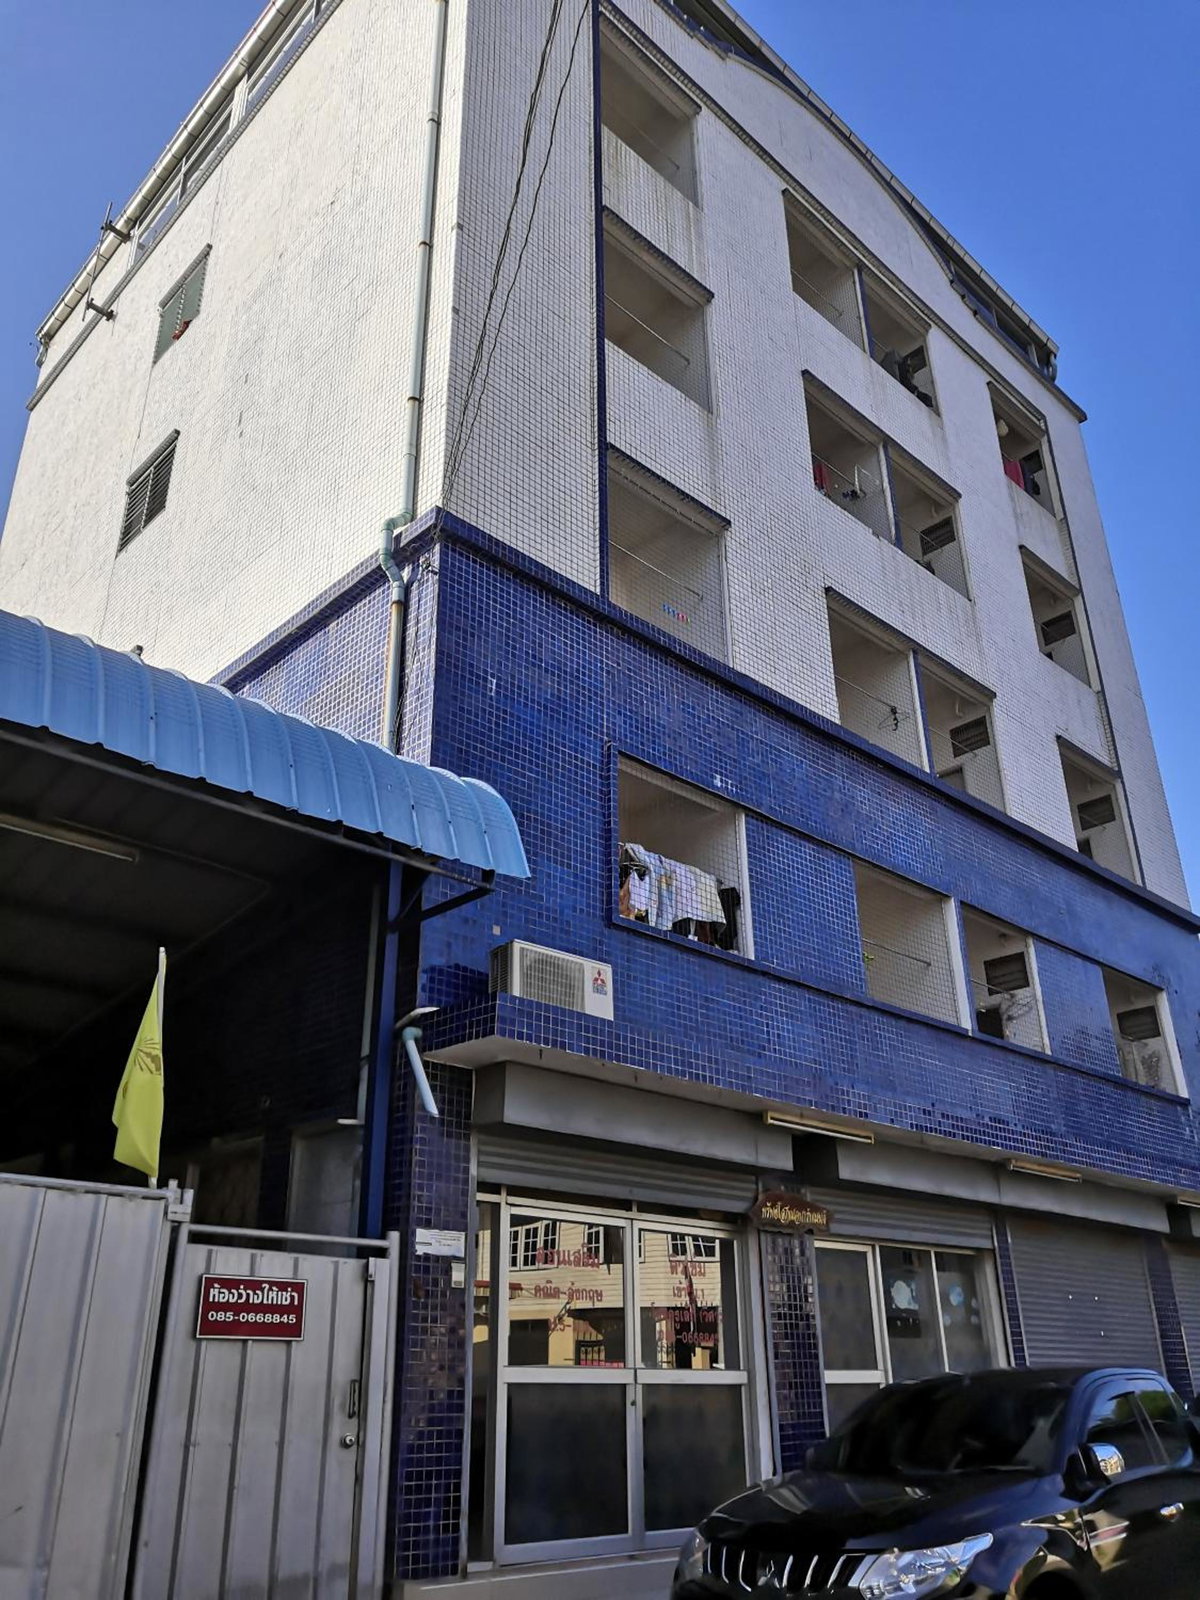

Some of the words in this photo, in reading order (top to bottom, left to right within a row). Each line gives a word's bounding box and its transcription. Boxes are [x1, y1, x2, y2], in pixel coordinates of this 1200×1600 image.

[209, 1282, 298, 1306] ห้องว่างให้เช่า
[208, 1311, 297, 1324] 085-0668845
